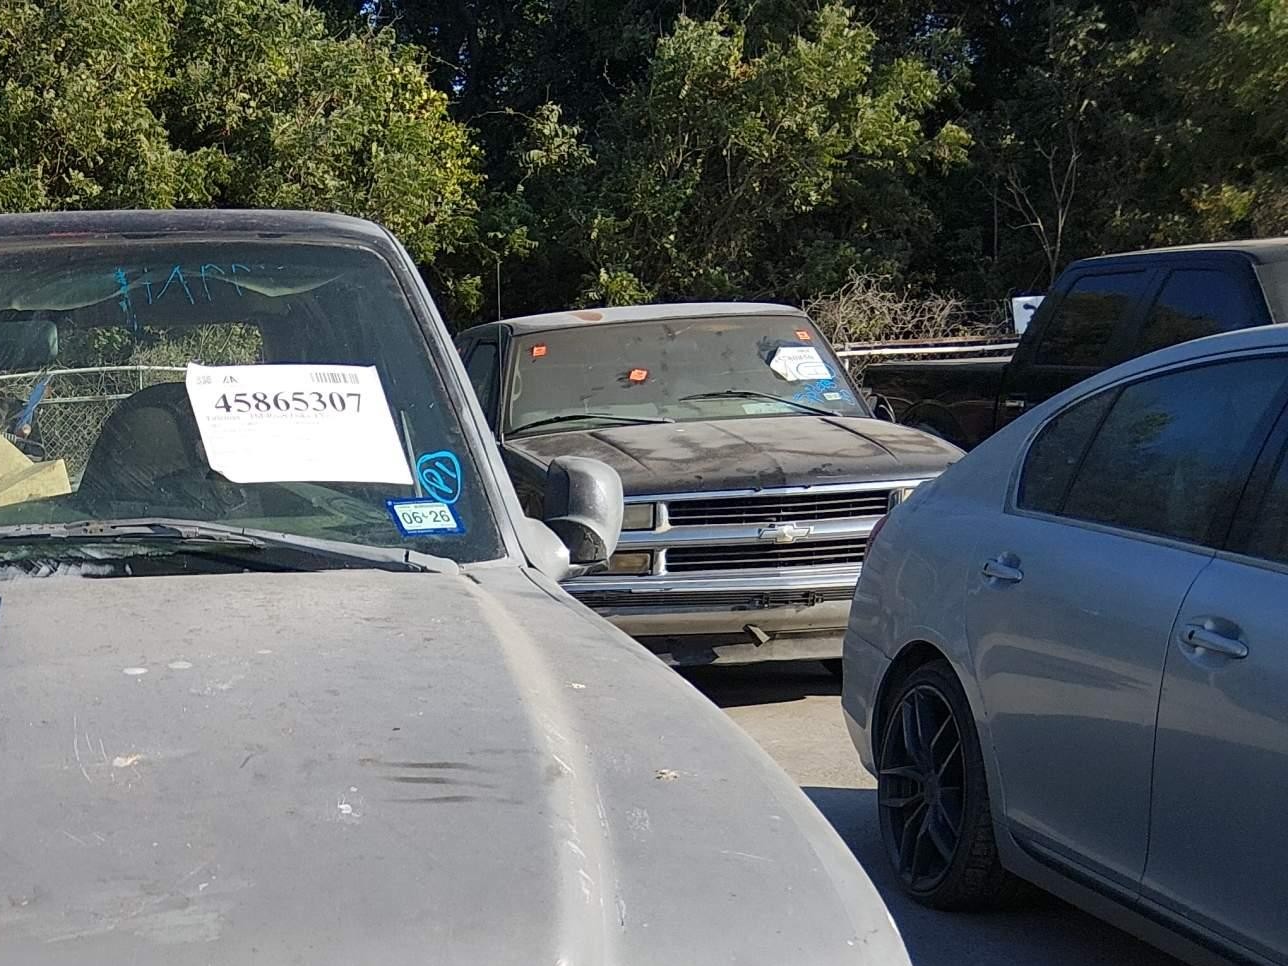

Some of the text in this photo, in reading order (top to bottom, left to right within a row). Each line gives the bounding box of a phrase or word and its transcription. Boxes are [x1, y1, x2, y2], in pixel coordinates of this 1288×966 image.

[214, 391, 361, 413] 45865307
[401, 509, 451, 525] 06 26
